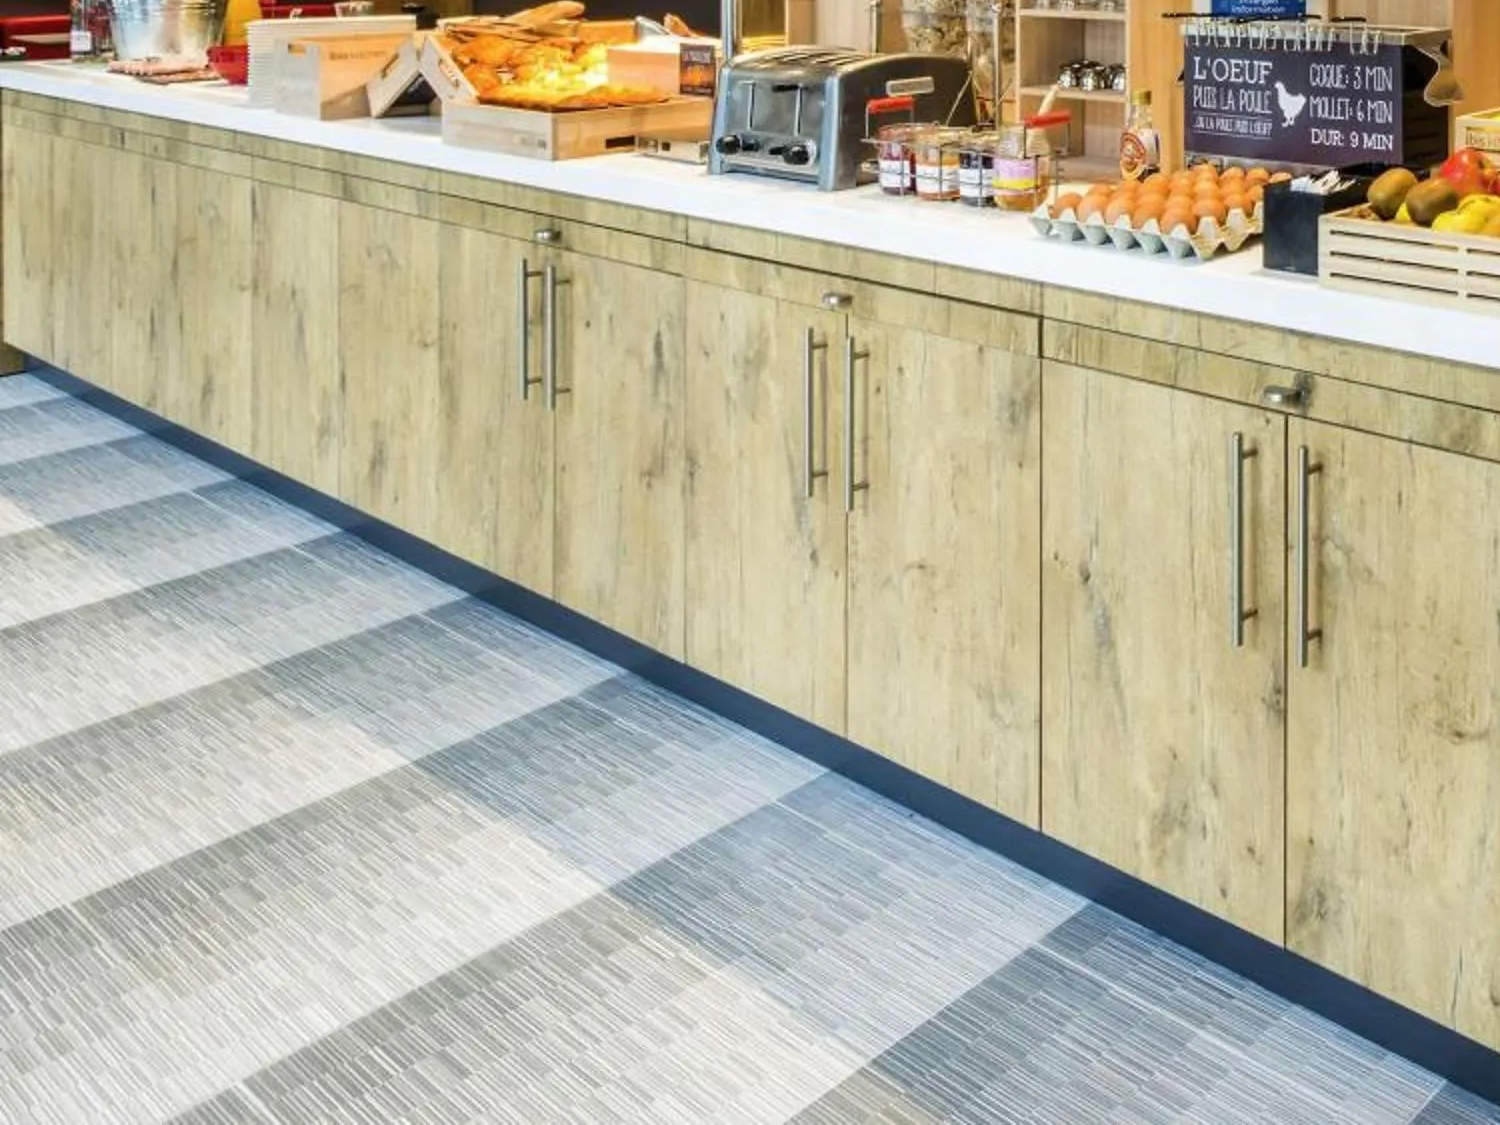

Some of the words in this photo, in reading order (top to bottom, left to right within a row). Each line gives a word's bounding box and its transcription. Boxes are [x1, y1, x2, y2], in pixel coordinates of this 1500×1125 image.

[1193, 56, 1273, 84] L'OEUF
[1309, 63, 1349, 89] COQUE:
[1353, 65, 1362, 90] 3
[1365, 66, 1393, 92] MIN
[1220, 87, 1235, 112] LA
[1239, 88, 1273, 114] POULE
[1309, 96, 1353, 121] MOLLET:
[1356, 98, 1365, 122] 6
[1367, 99, 1393, 124] MIN
[1311, 128, 1345, 147] DUR:
[1349, 131, 1359, 148] 9
[1362, 132, 1394, 152] MIN
